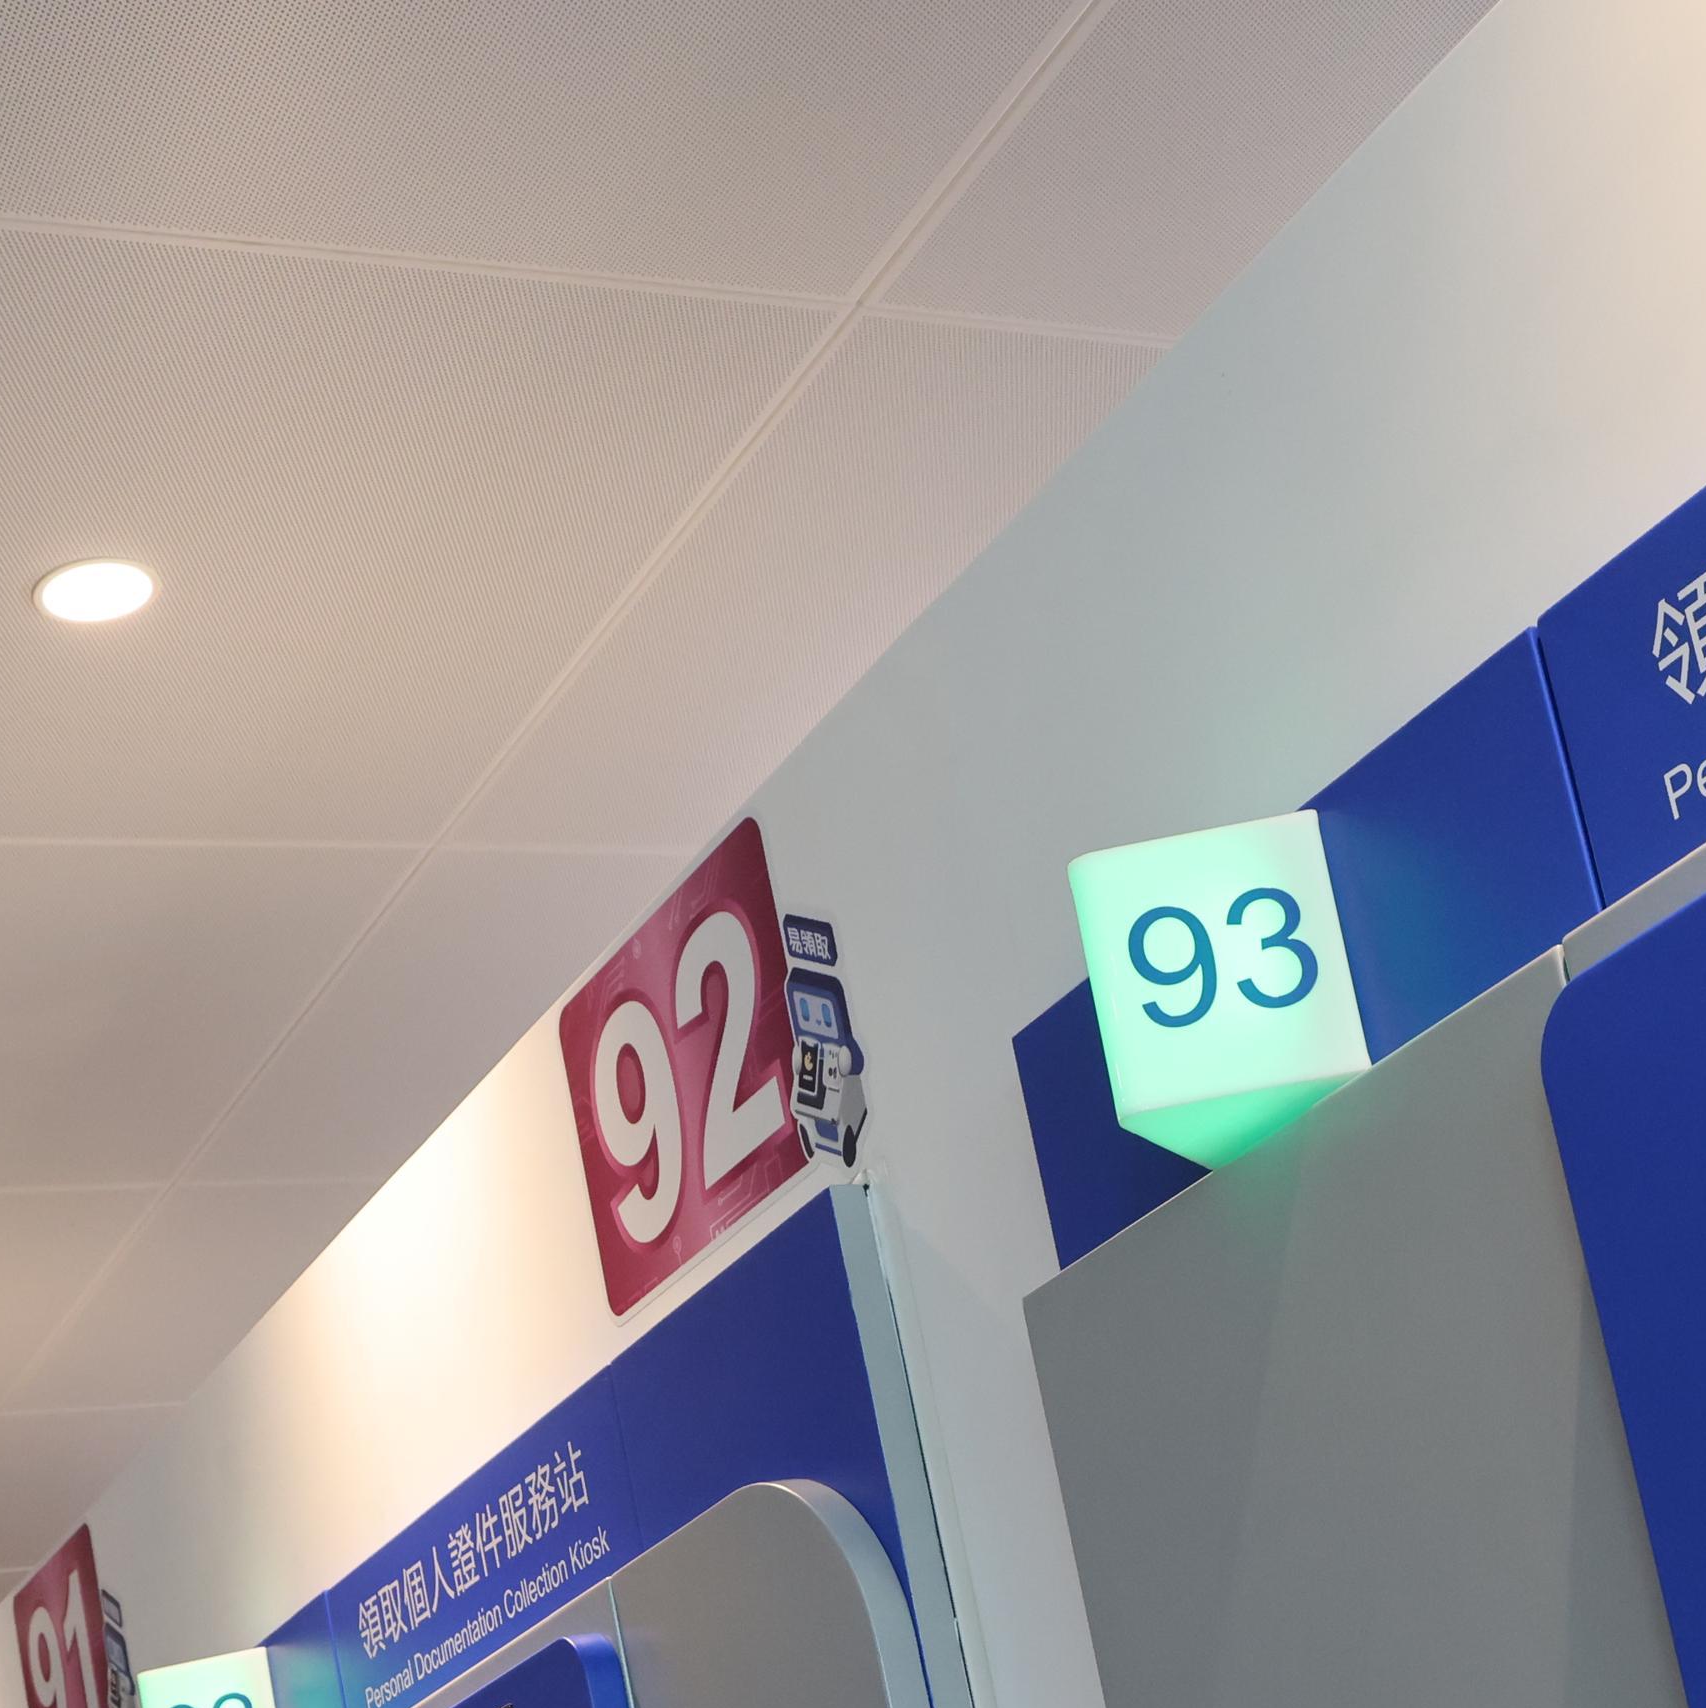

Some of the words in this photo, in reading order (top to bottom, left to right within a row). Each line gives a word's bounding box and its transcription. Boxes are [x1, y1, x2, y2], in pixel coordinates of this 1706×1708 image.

[1127, 887, 1319, 1029] 93
[592, 909, 786, 1245] 92
[358, 1441, 590, 1659] 領取個人證件服務站
[415, 1603, 503, 1680] Documentation
[503, 1558, 568, 1619] Collection
[568, 1525, 611, 1575] Kiosk
